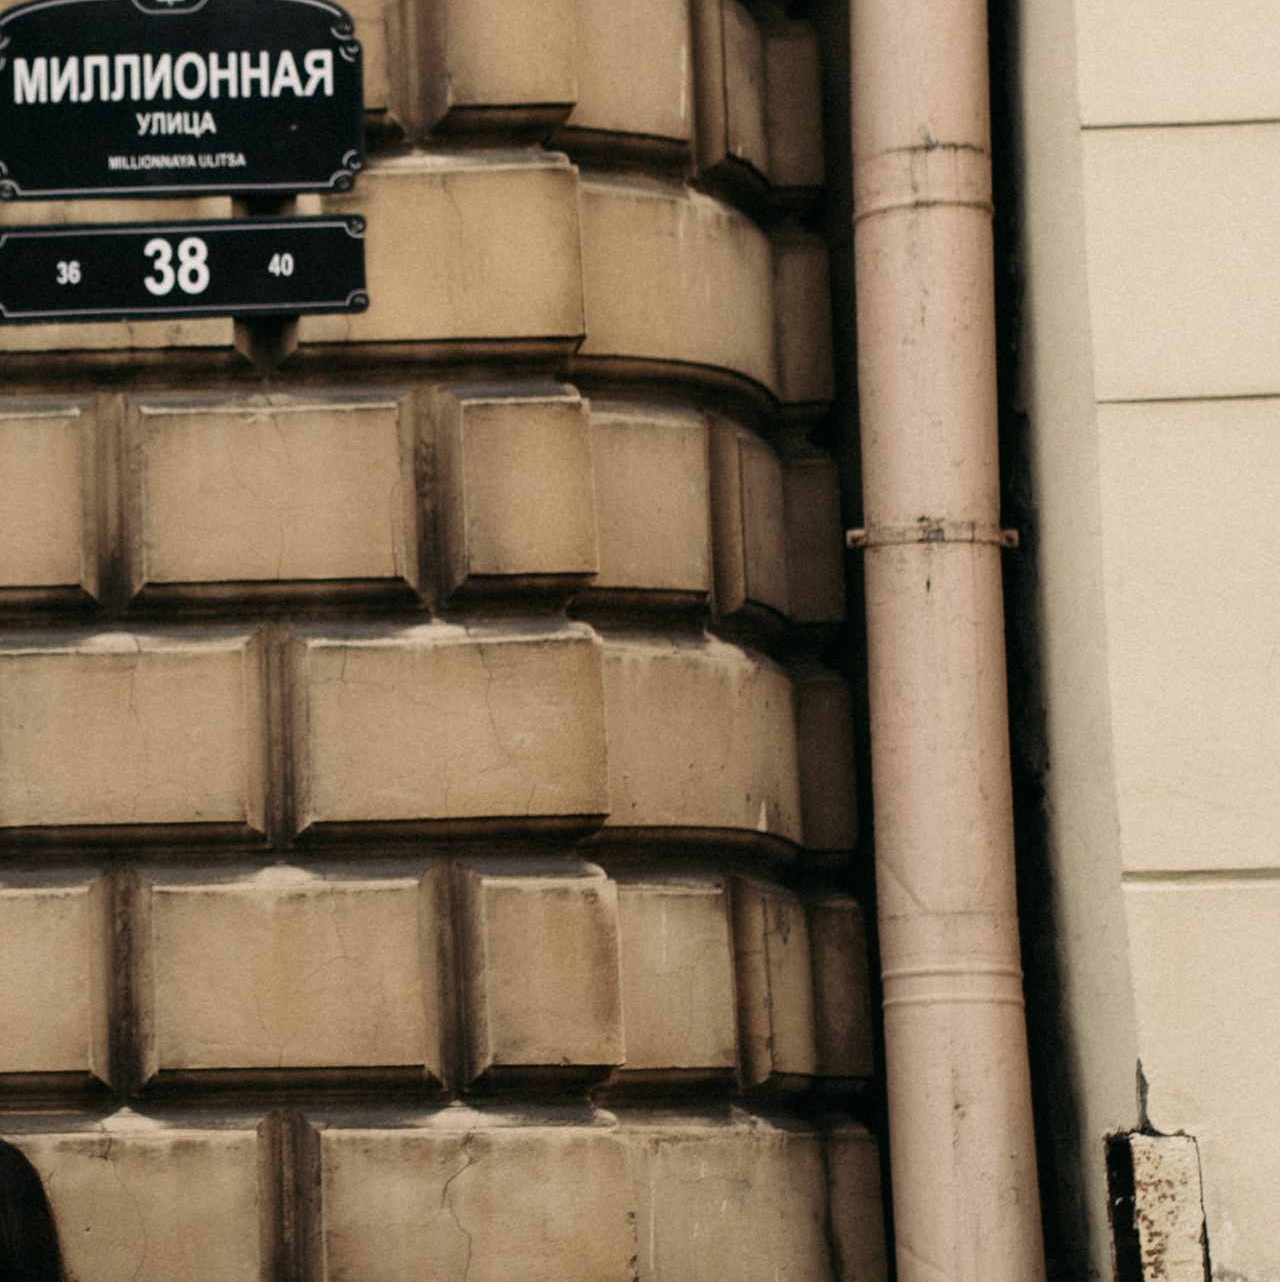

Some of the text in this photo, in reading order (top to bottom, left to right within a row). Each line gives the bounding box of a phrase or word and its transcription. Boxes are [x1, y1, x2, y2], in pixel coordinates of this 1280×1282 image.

[13, 49, 334, 105] МИЛЛИОННАЯ
[136, 110, 218, 138] УЛИЦА
[108, 152, 247, 170] MILLIONNAYA ULITSA
[56, 237, 295, 296] 36 38 40
